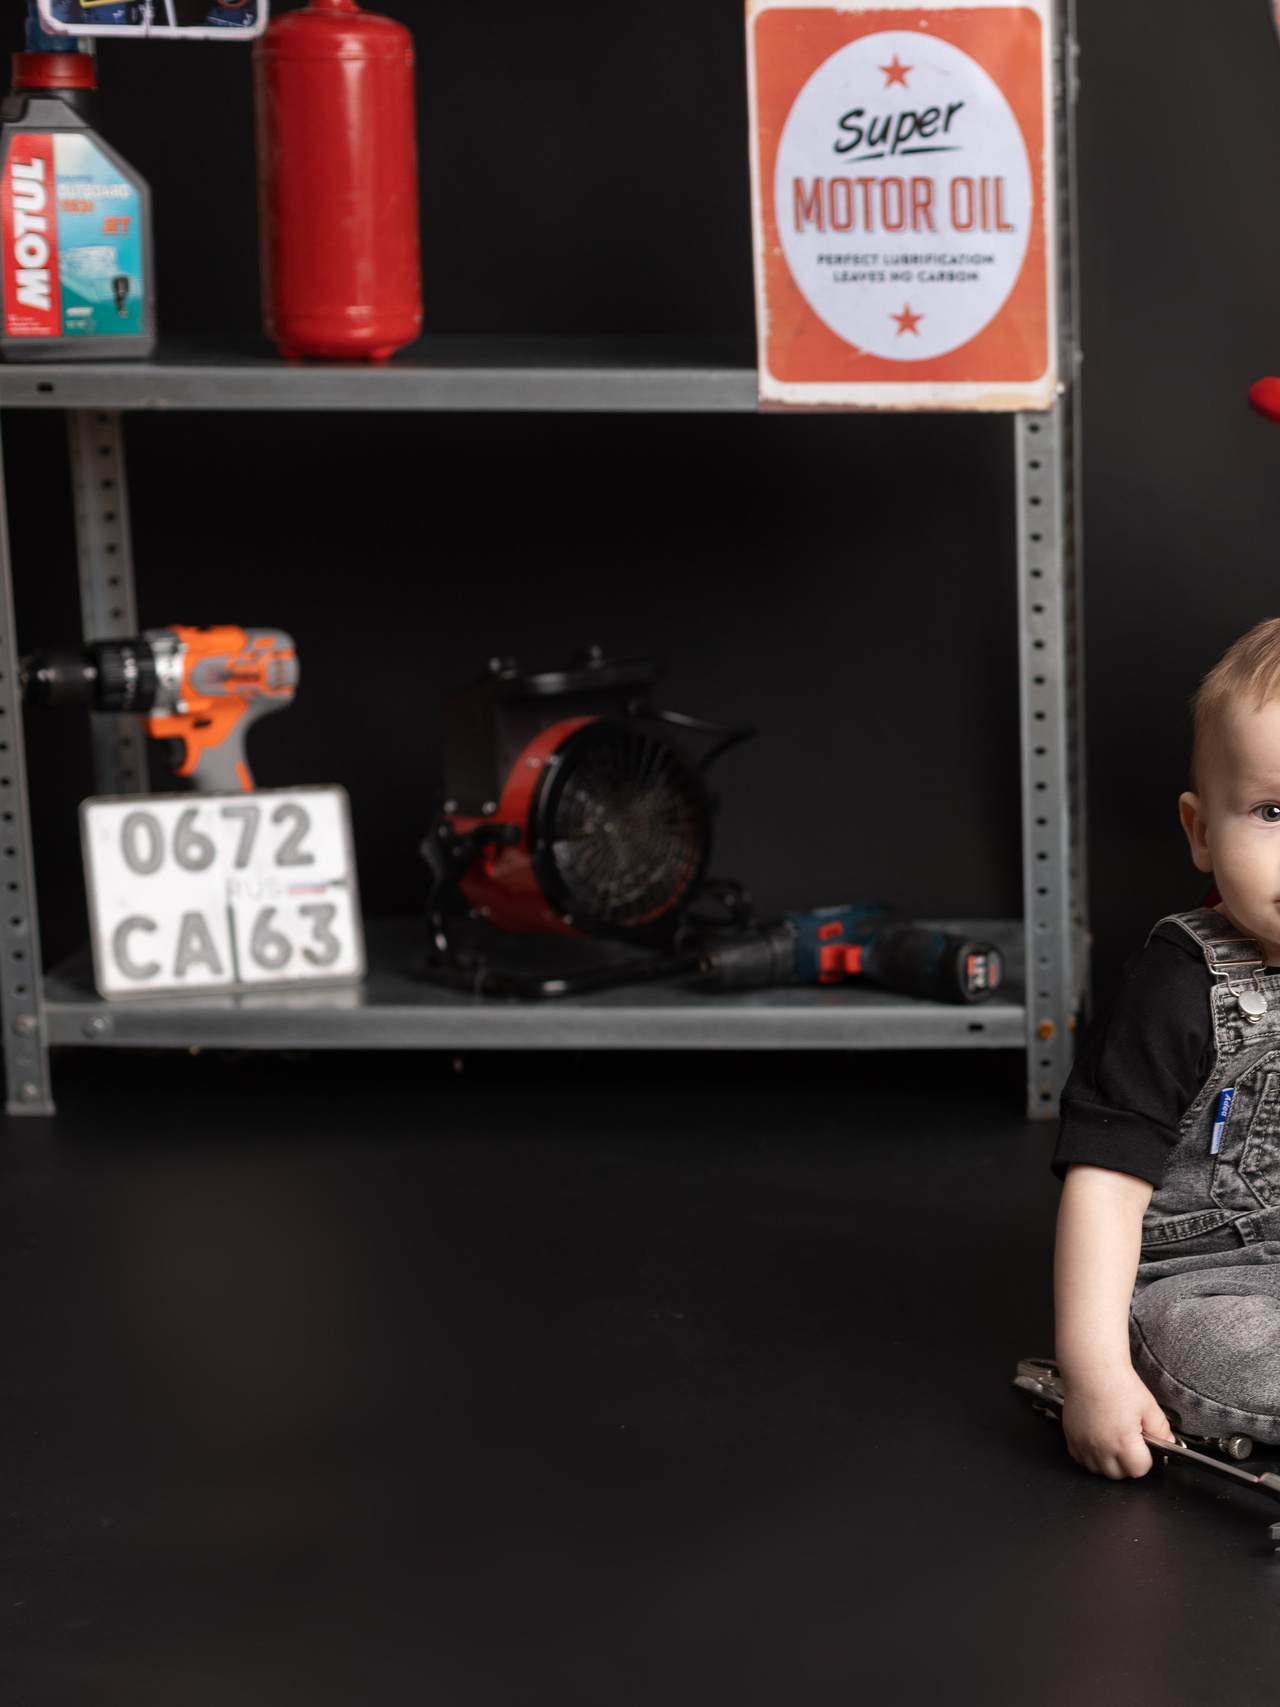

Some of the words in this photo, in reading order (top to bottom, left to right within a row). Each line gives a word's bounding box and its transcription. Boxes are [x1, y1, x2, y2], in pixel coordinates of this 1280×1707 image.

[833, 100, 965, 156] Super
[793, 176, 936, 233] MOTOR
[949, 175, 1014, 233] OIL
[12, 157, 52, 312] MOTUL
[817, 253, 879, 265] PERFECT
[833, 271, 885, 283] LEAVES
[889, 271, 913, 283] NO
[917, 271, 979, 283] CARBON
[120, 802, 315, 877] 0672
[112, 912, 225, 981] CA
[250, 903, 341, 971] 63
